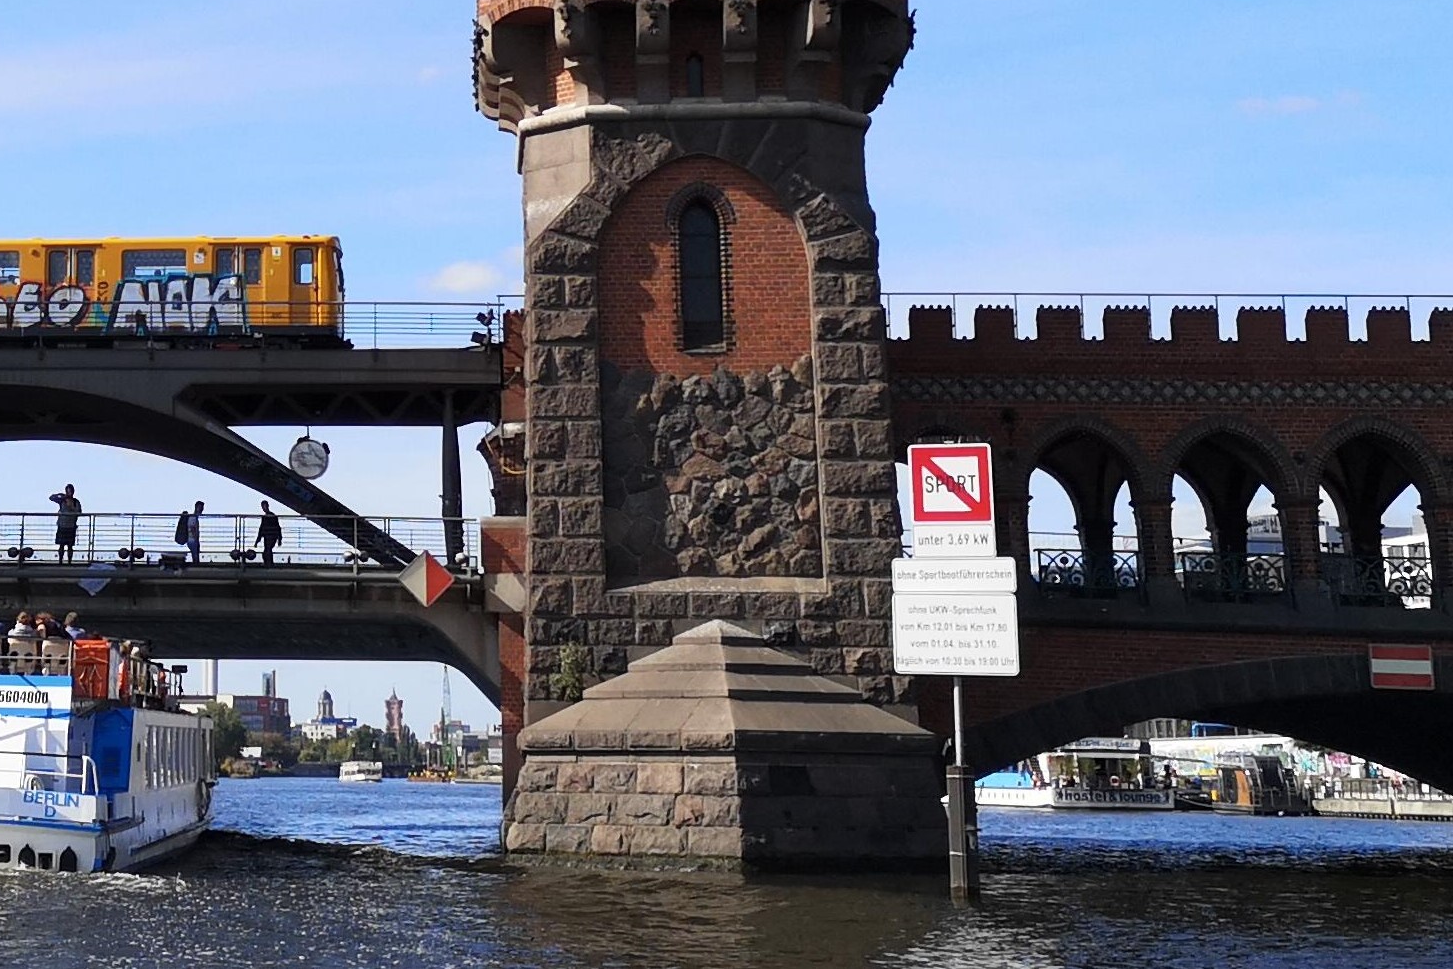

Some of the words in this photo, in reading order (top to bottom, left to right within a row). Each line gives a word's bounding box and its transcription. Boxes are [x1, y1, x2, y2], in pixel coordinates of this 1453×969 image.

[925, 474, 976, 493] SPORT
[918, 535, 944, 546] unter
[973, 533, 989, 545] kW
[897, 570, 917, 580] ohne
[919, 568, 1012, 581] Sportbootführerschein
[908, 606, 927, 615] ohne
[917, 622, 930, 631] Km
[955, 623, 968, 632] bis
[970, 623, 984, 632] Km
[958, 640, 972, 649] bis
[964, 657, 975, 666] bis
[1001, 657, 1015, 666] Uhr
[23, 790, 80, 808] BERLIN
[1065, 791, 1107, 802] hostel
[1109, 791, 1117, 802] &
[1120, 791, 1161, 802] lounge
[44, 804, 56, 818] D
